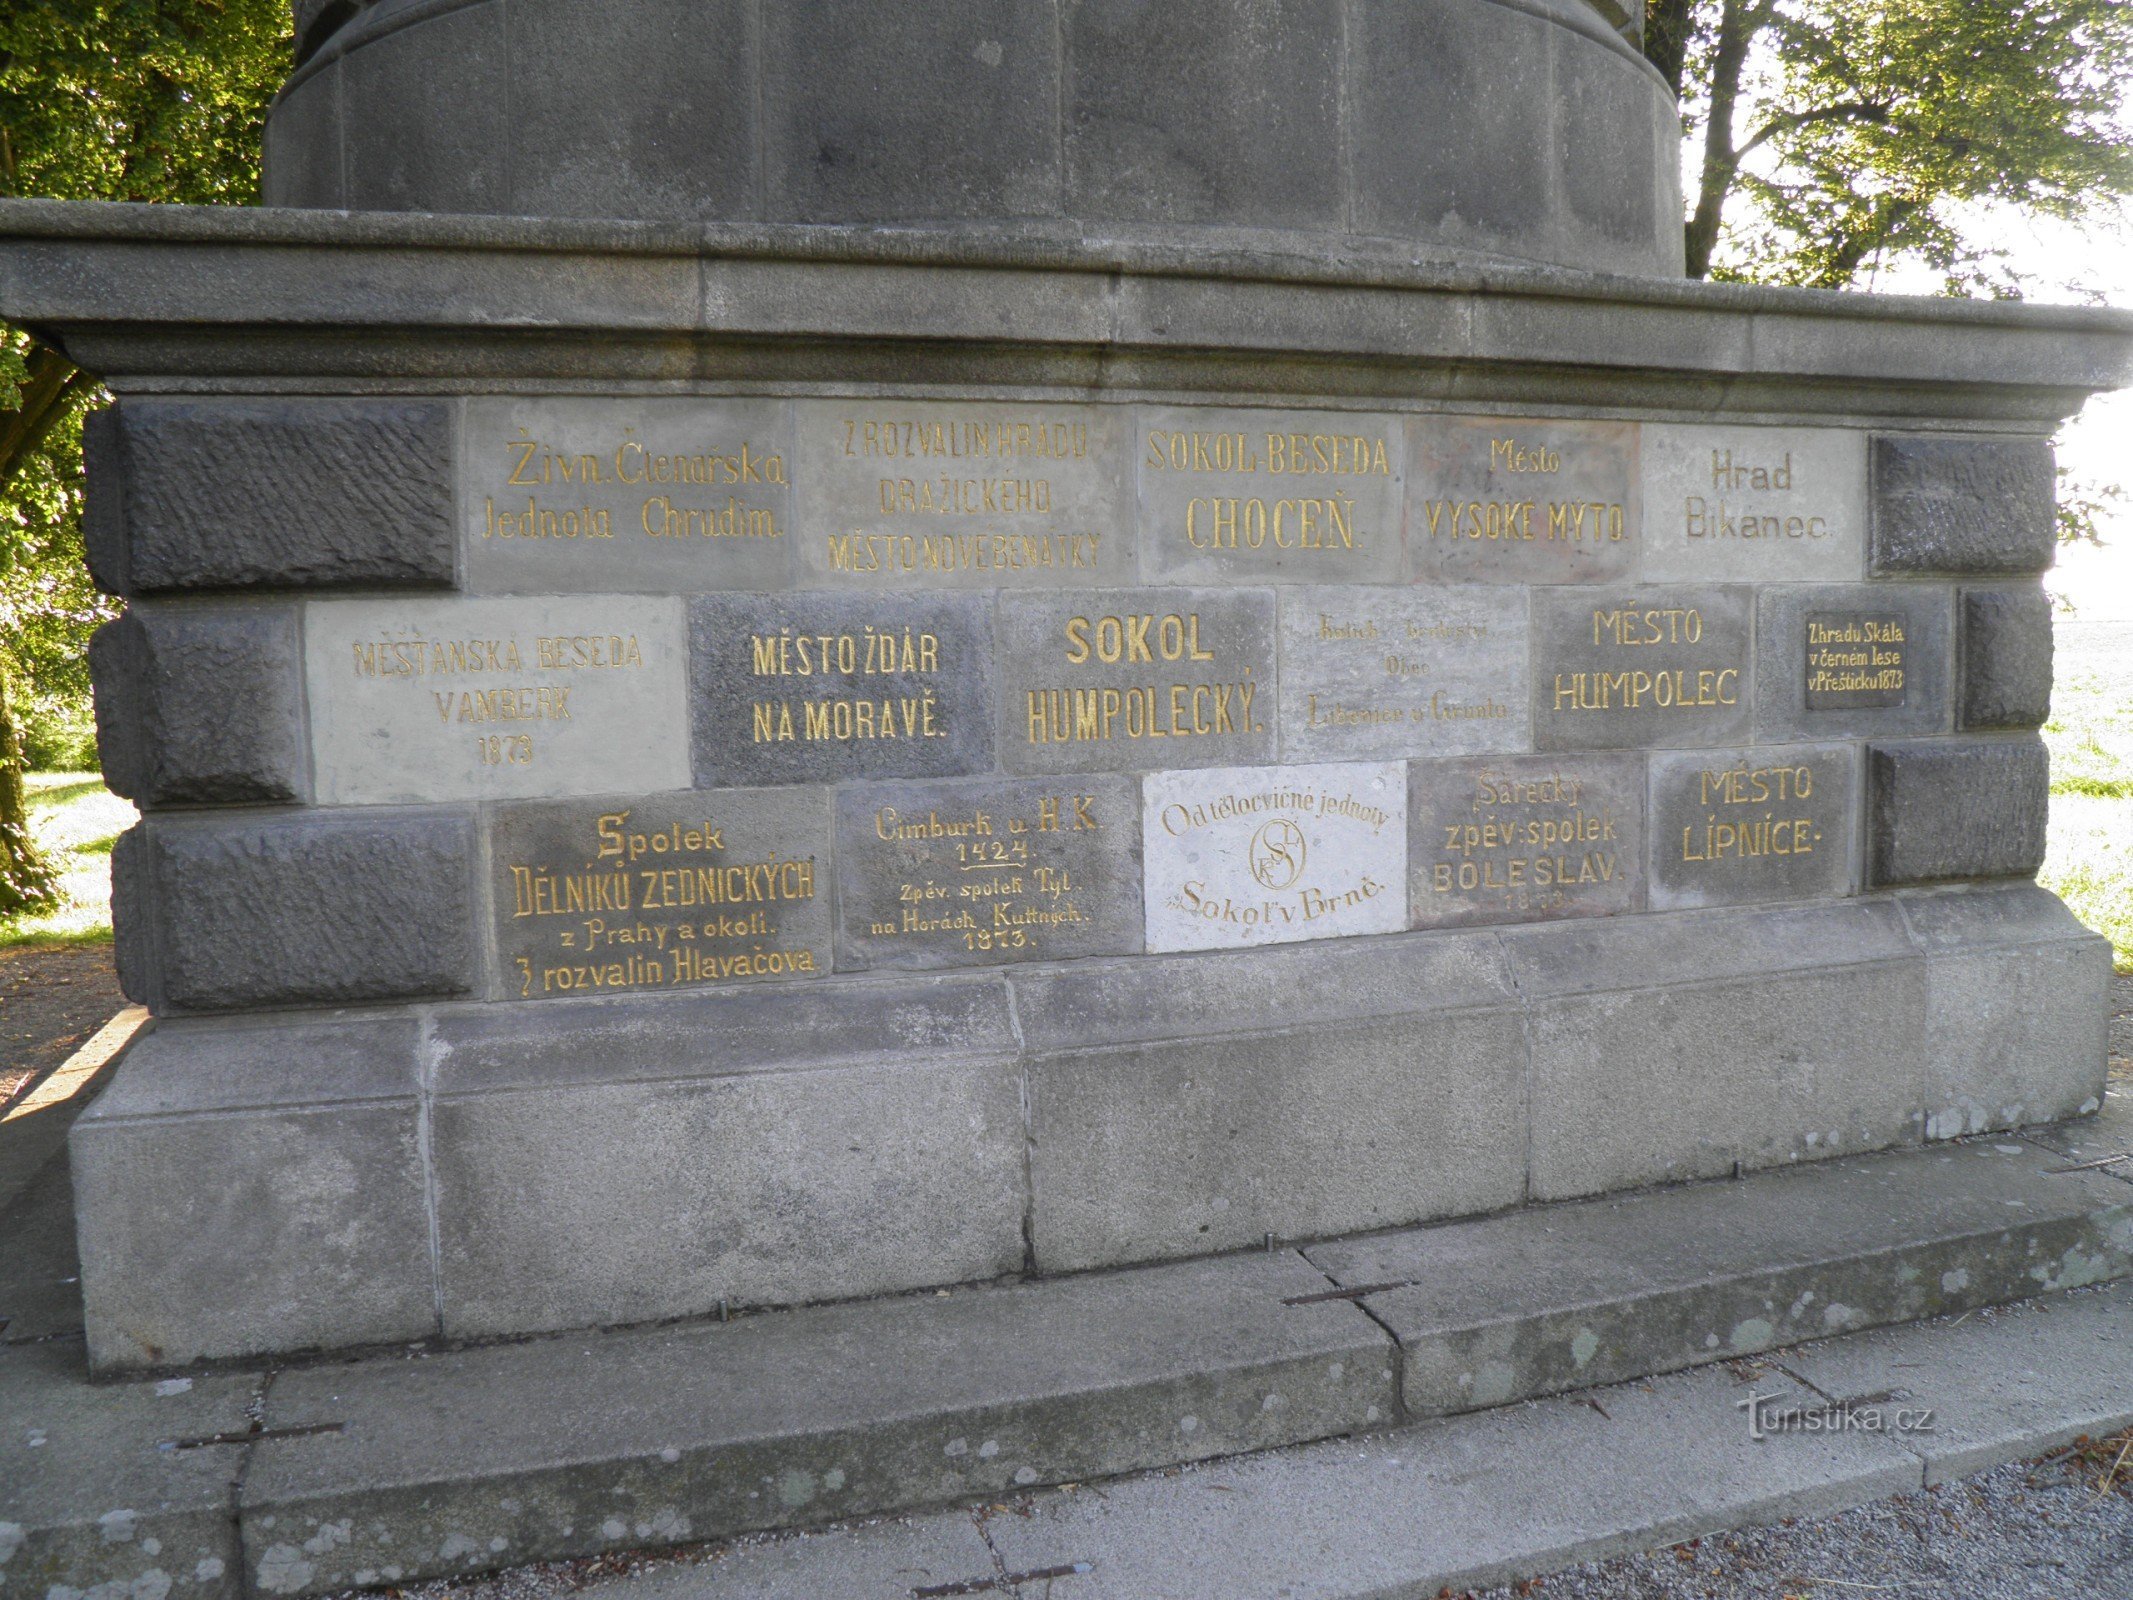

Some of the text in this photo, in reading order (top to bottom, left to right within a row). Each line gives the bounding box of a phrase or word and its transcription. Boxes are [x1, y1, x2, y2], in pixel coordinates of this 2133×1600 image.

[506, 427, 613, 485] Živn.
[864, 421, 989, 457] ROZVALIN
[999, 423, 1086, 458] HRADU
[1712, 449, 1791, 490] Hrad
[482, 496, 784, 539] Jednota Chrudim.
[1186, 488, 1365, 550] CHOCEŇ.
[828, 528, 917, 572] MĚSTO
[1065, 613, 1215, 665] SOKOL
[1593, 599, 1703, 645] MĚSTO
[1864, 621, 1904, 643] Skála
[537, 634, 644, 669] BESEDA
[752, 625, 938, 675] MĚSTO ŽDÁR
[1820, 646, 1868, 667] černém
[1871, 645, 1901, 666] lese
[432, 686, 573, 723] VAMBERK
[1028, 666, 1263, 744] HUMPOLECKÝ.
[1553, 669, 1738, 710] HUMPOLEC
[753, 688, 947, 743] NA MORAVĚ.
[478, 734, 534, 766] 1873
[1701, 760, 1812, 805] MĚSTO
[875, 806, 993, 841] Cimburk
[1009, 817, 1028, 834] u
[1161, 803, 1208, 837] Od
[1316, 790, 1389, 836] jednoty
[598, 810, 725, 861] Spolek
[641, 852, 815, 909] ZEDNICKÝCH
[900, 880, 950, 904] Zpěv.
[960, 877, 1023, 902] spolek
[1434, 852, 1626, 892] BOLESLAV.
[560, 931, 575, 947] z
[584, 918, 667, 950] Prahy
[679, 922, 695, 940] a
[871, 919, 897, 935] na
[903, 908, 977, 933] Horách
[544, 953, 663, 991] rozvalin
